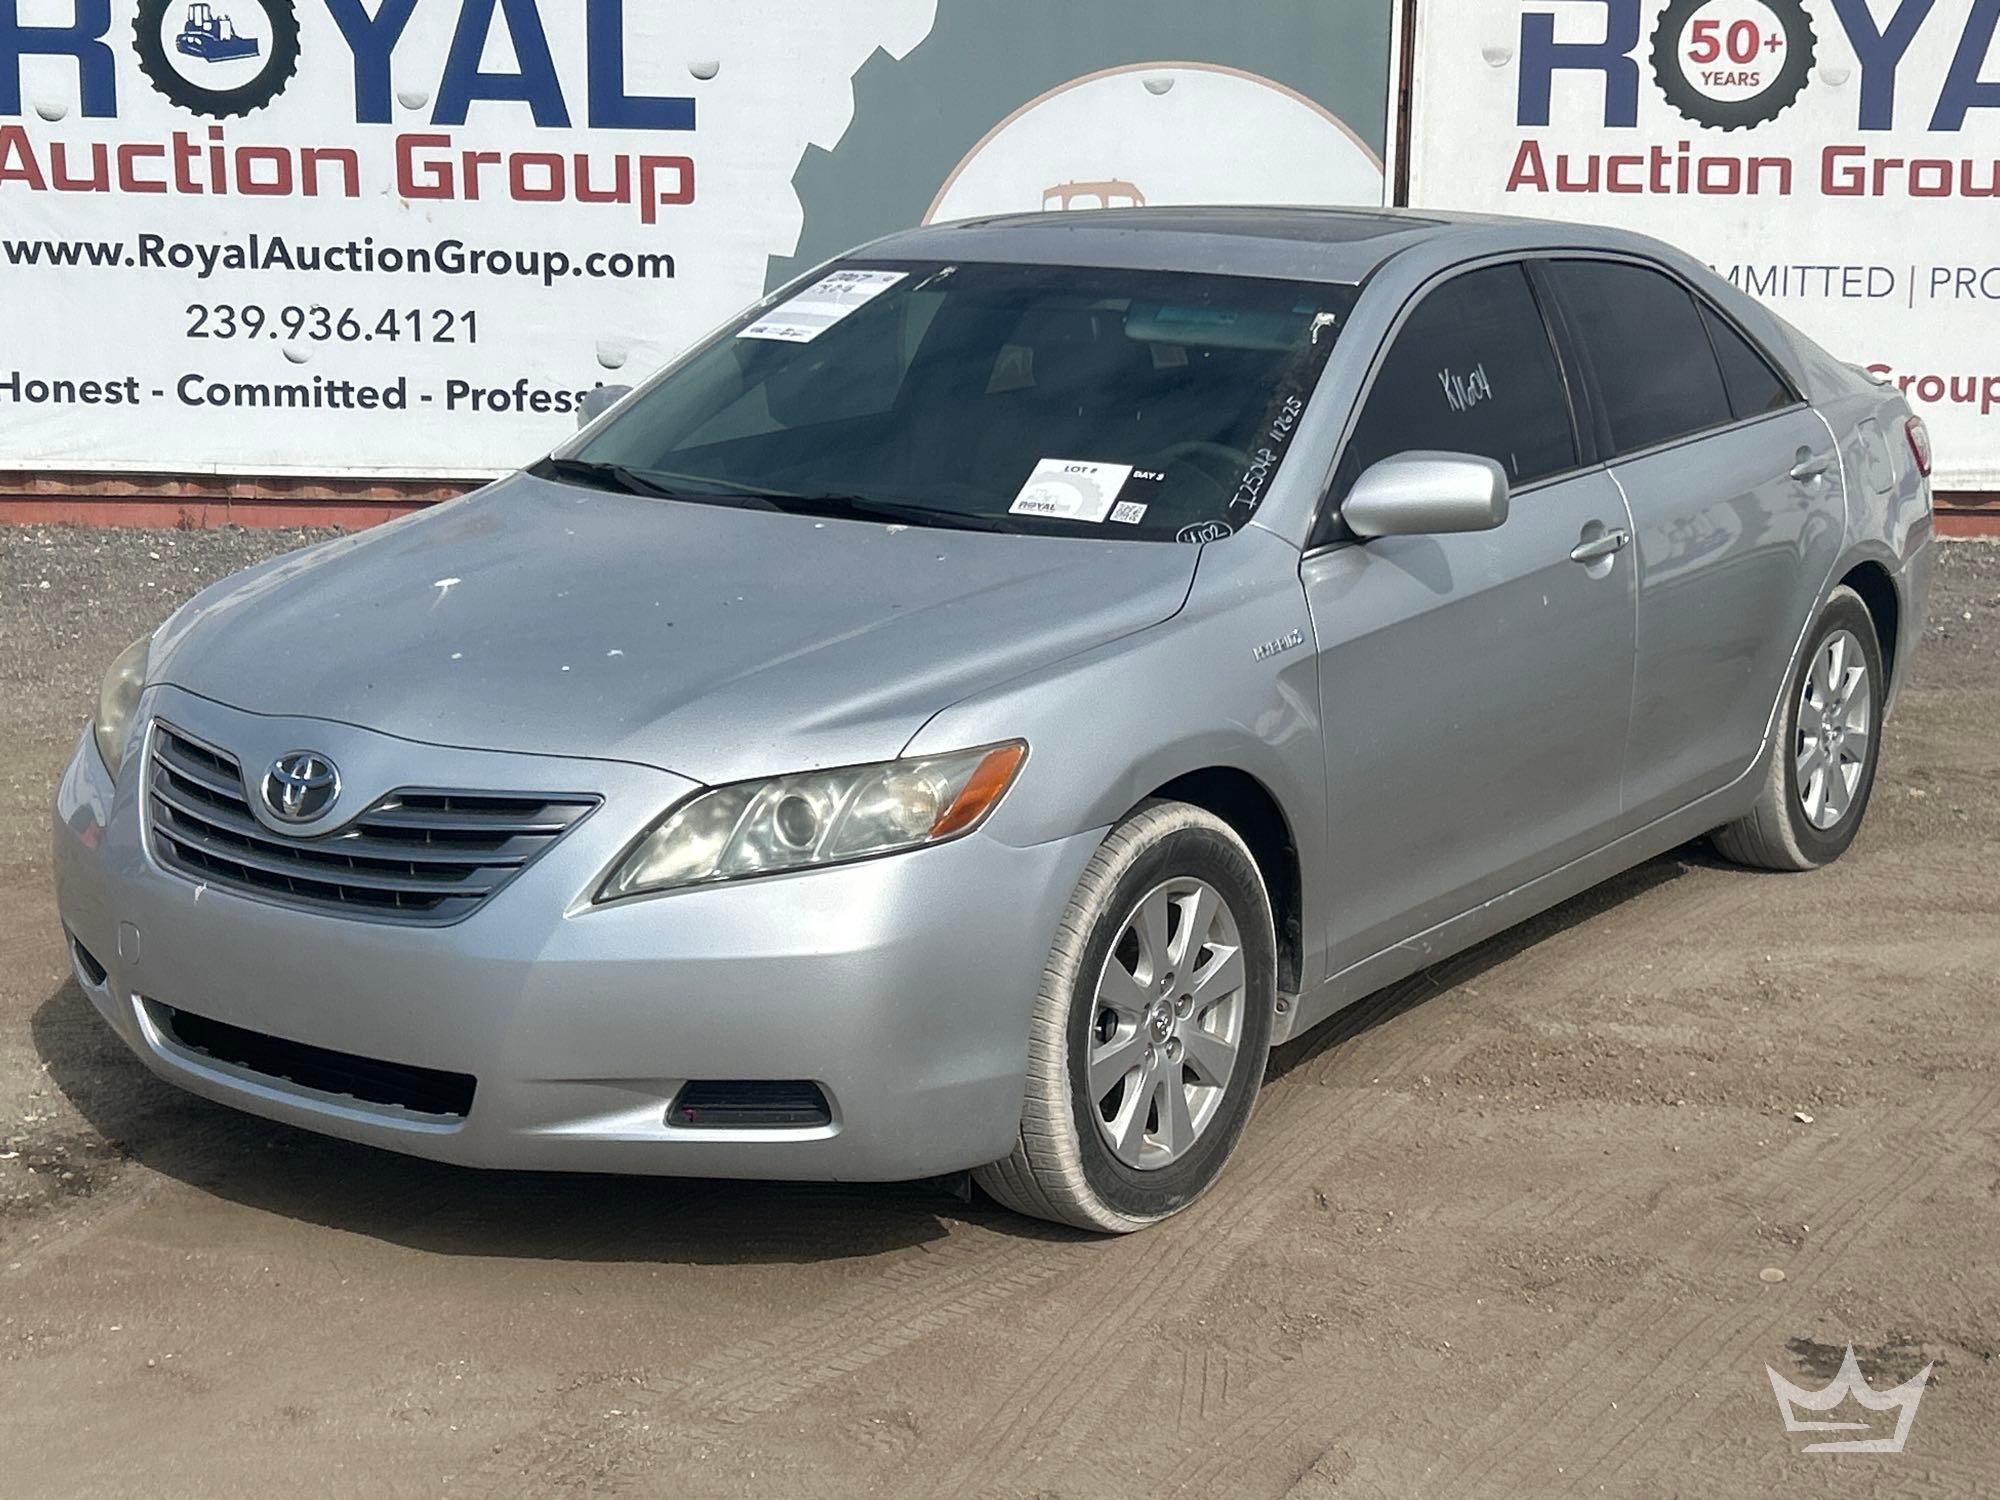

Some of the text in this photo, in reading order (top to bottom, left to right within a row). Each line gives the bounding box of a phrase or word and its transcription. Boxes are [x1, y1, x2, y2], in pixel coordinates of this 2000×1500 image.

[1688, 20, 1783, 65] 50+
[1701, 72, 1760, 87] YEARS
[0, 125, 695, 225] Auction Group
[1506, 140, 1792, 196] Auction
[2, 233, 676, 286] www.RoyalAuctionGroup.com
[186, 305, 478, 344] 239.936.4121
[0, 371, 139, 406] Honest
[177, 374, 407, 410] Committed
[1064, 465, 1086, 473] LOT
[1133, 470, 1156, 480] DAY
